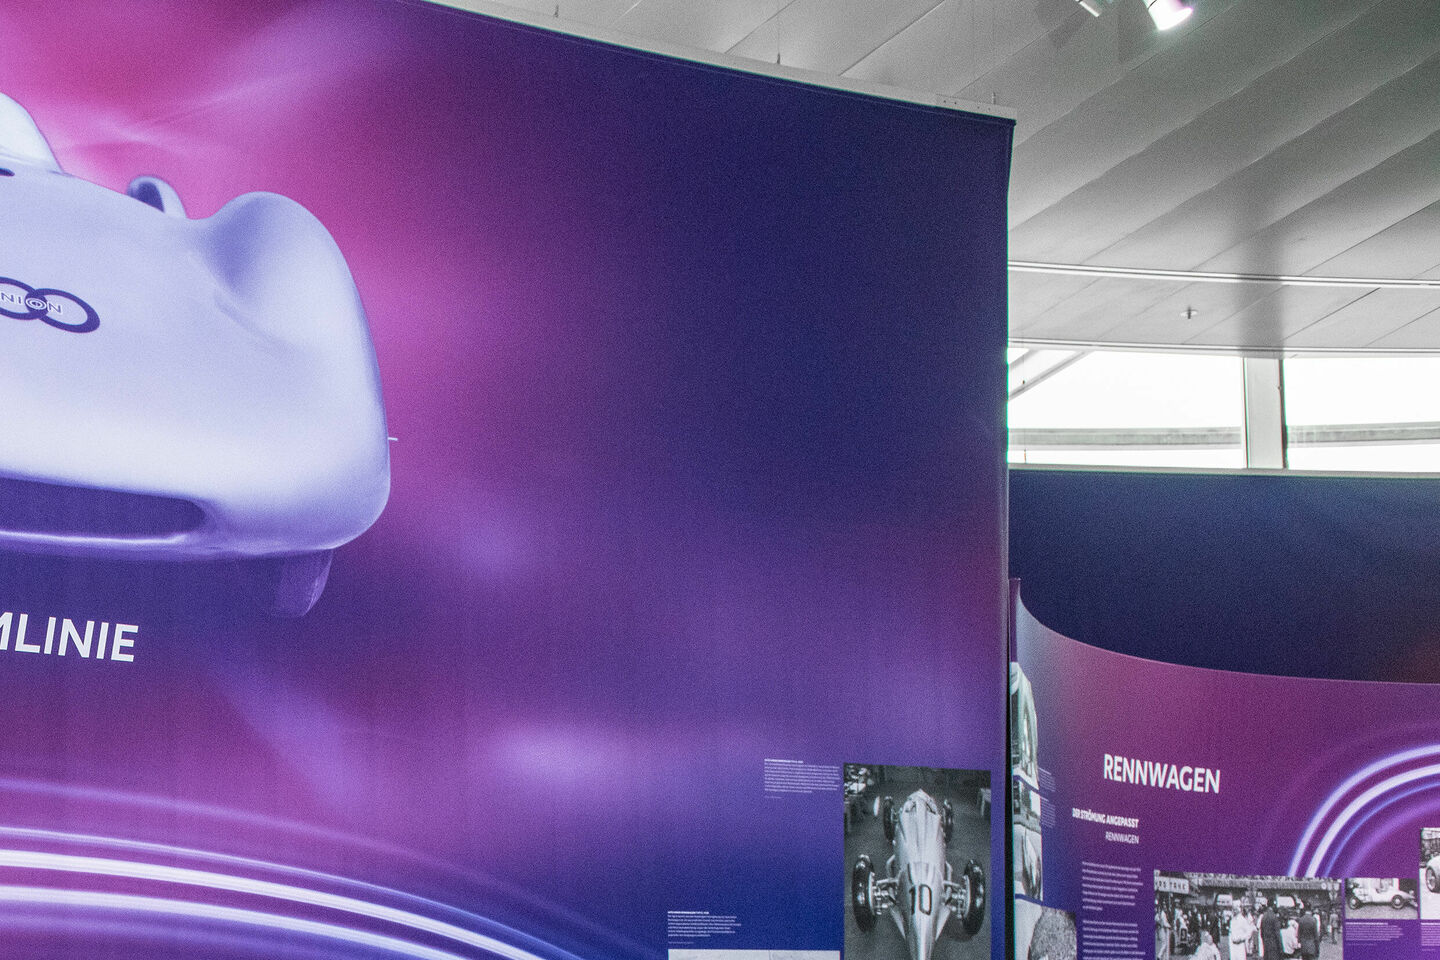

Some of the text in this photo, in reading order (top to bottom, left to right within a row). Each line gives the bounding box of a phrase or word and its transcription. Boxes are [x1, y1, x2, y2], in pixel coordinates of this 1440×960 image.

[1104, 754, 1220, 794] RENNWAGEN
[1106, 814, 1139, 828] ANGEPASST
[1106, 832, 1139, 844] RENNWAGEN
[909, 883, 932, 916] 10
